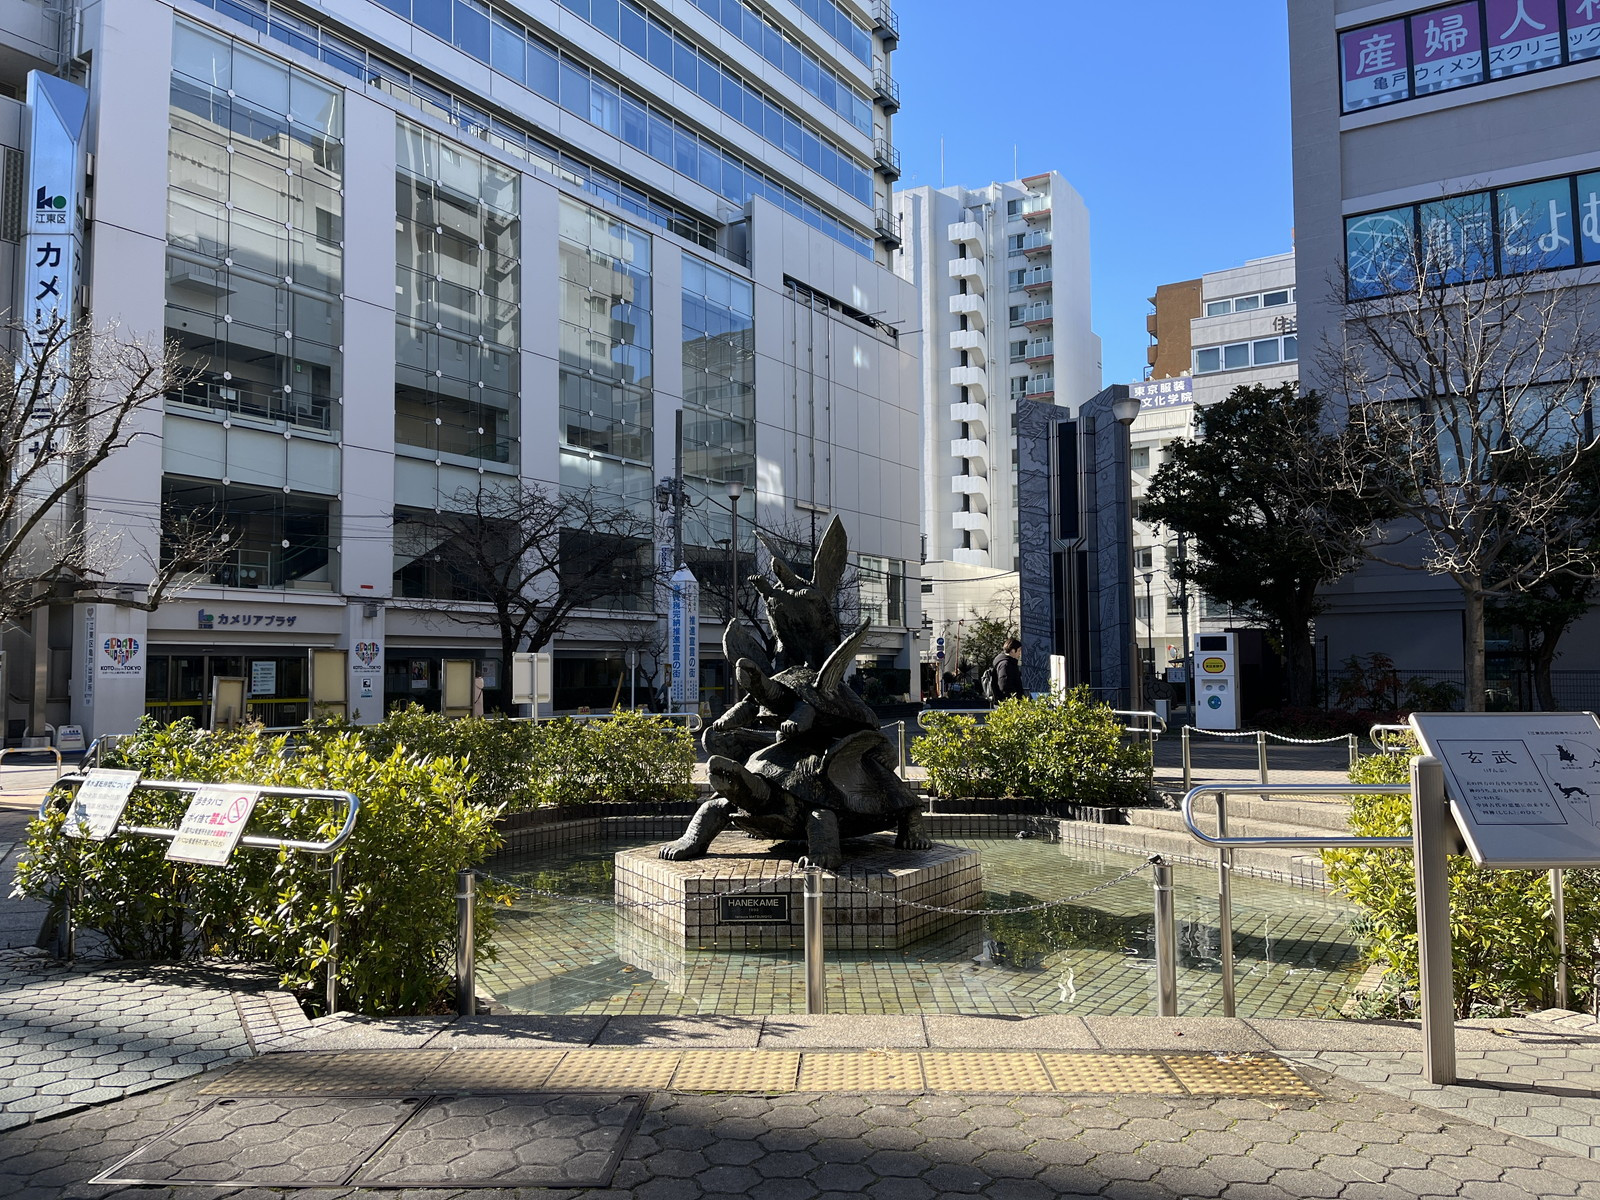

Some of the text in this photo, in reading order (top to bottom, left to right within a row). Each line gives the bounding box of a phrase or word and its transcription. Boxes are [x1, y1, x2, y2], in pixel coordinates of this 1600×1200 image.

[35, 213, 67, 224] 江東区
[1134, 380, 1186, 397] 東京服装
[1141, 391, 1193, 408] 文化学院
[217, 613, 297, 628] カメリアプラザ
[103, 637, 140, 650] SPORTS
[688, 615, 696, 678] 推進宣言の街
[1461, 750, 1518, 765] 玄武
[195, 796, 224, 807] 歩きタバコ
[727, 898, 779, 907] HANEKAME
